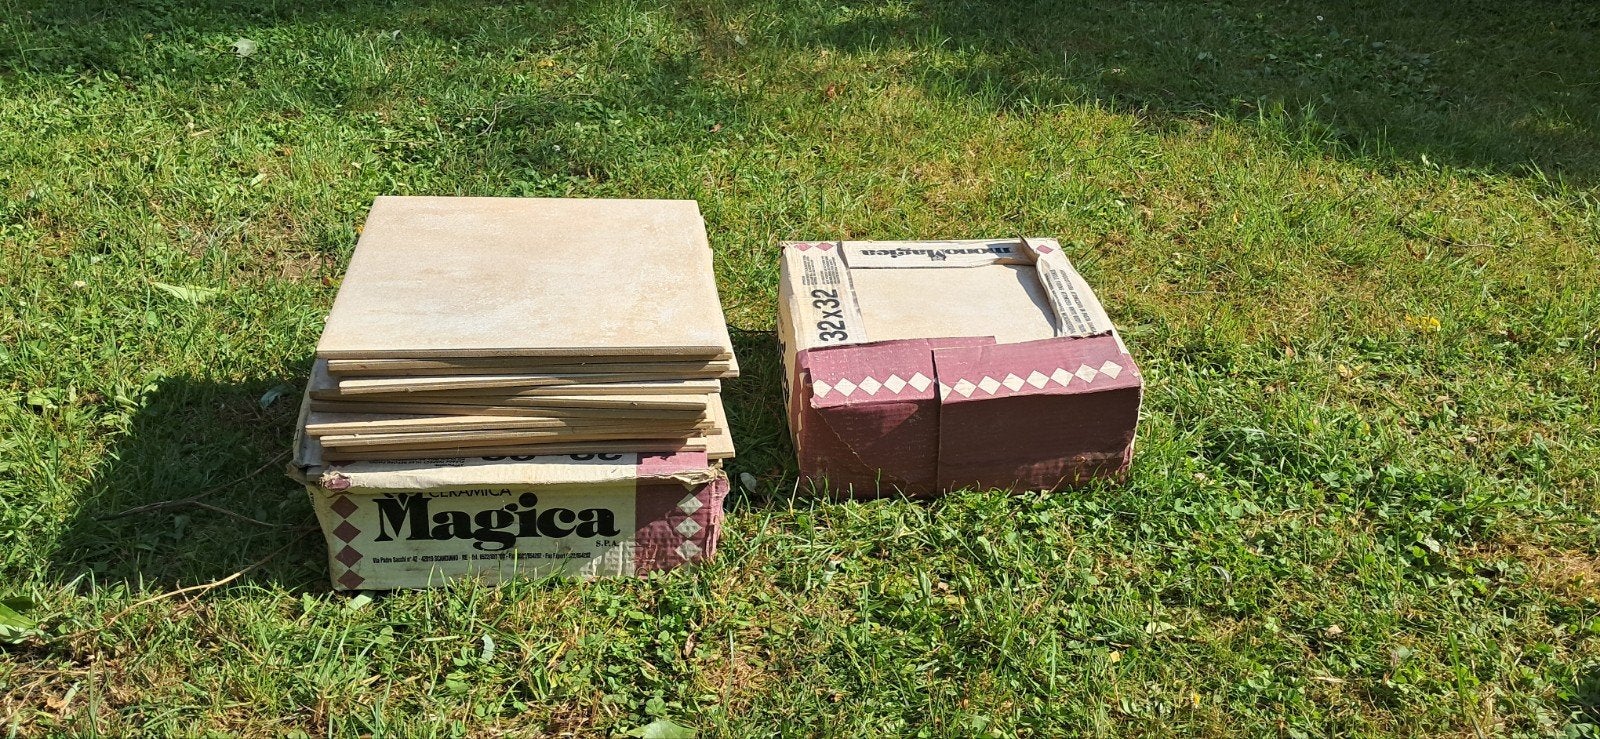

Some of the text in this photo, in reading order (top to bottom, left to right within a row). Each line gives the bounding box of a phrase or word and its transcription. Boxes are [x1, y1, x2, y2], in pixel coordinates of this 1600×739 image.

[861, 248, 1012, 261] monoMagica
[811, 288, 848, 342] 32x32
[373, 492, 621, 551] Magica
[595, 539, 619, 548] S.P.A.
